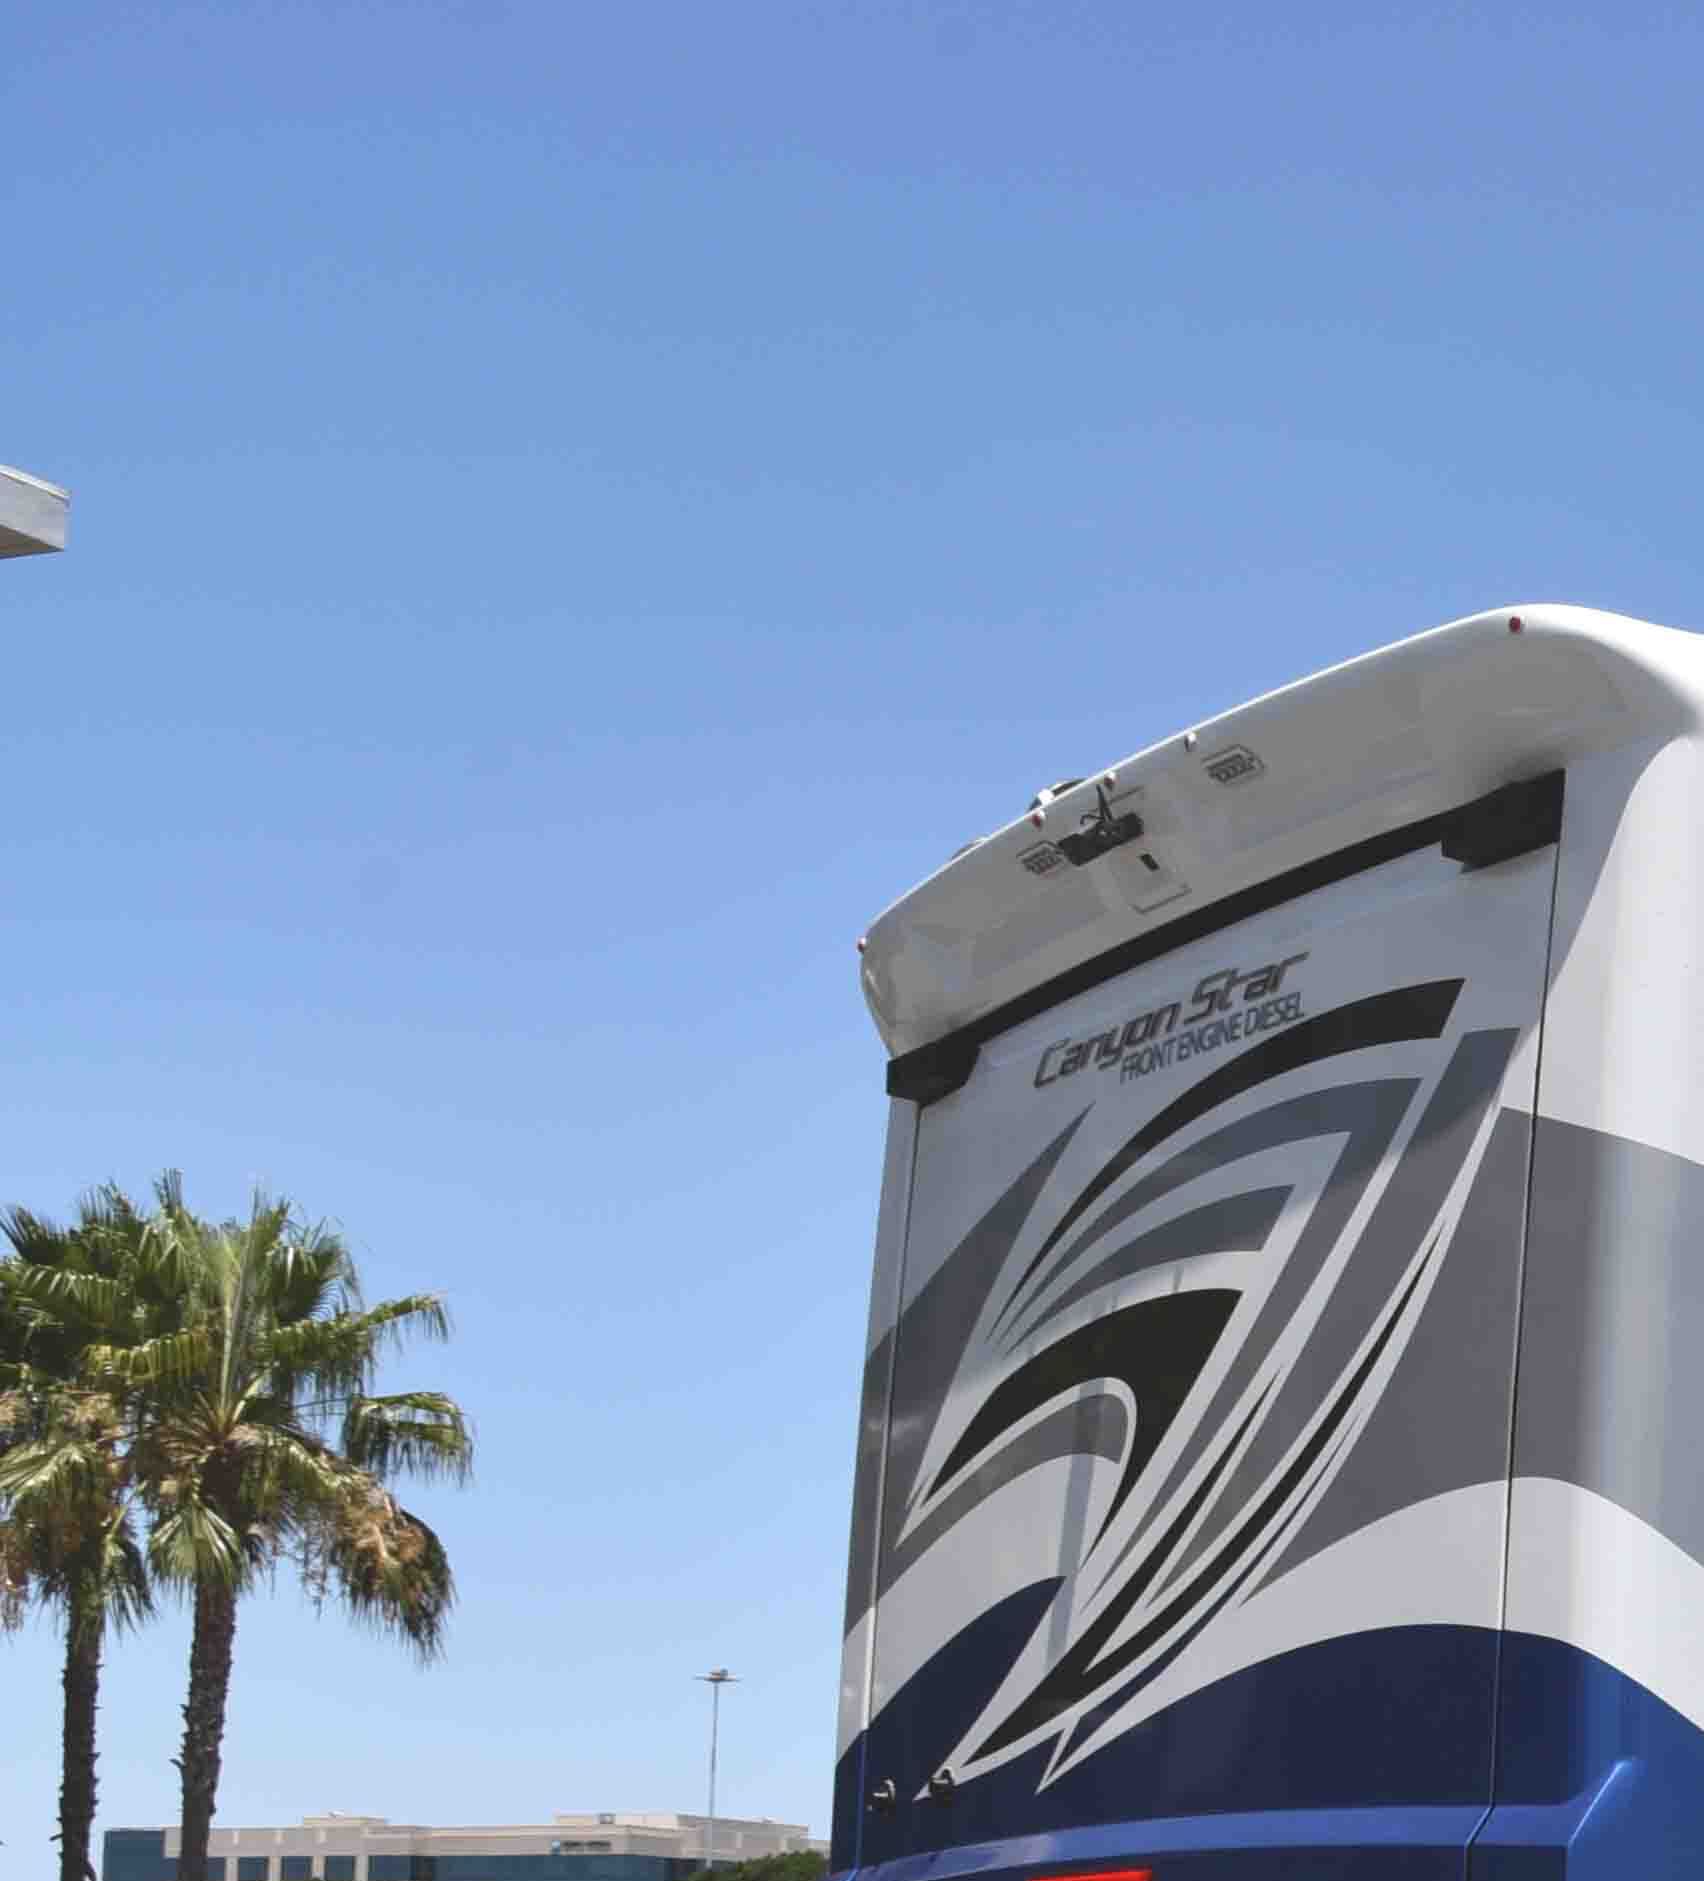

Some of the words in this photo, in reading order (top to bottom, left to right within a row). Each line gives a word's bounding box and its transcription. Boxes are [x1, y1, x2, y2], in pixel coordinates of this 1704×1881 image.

[1033, 1003, 1181, 1088] Canyon
[1184, 951, 1311, 1024] Star
[1120, 1042, 1177, 1084] FRONT
[1178, 1011, 1242, 1061] ENGINE
[1243, 992, 1305, 1036] DIESEL
